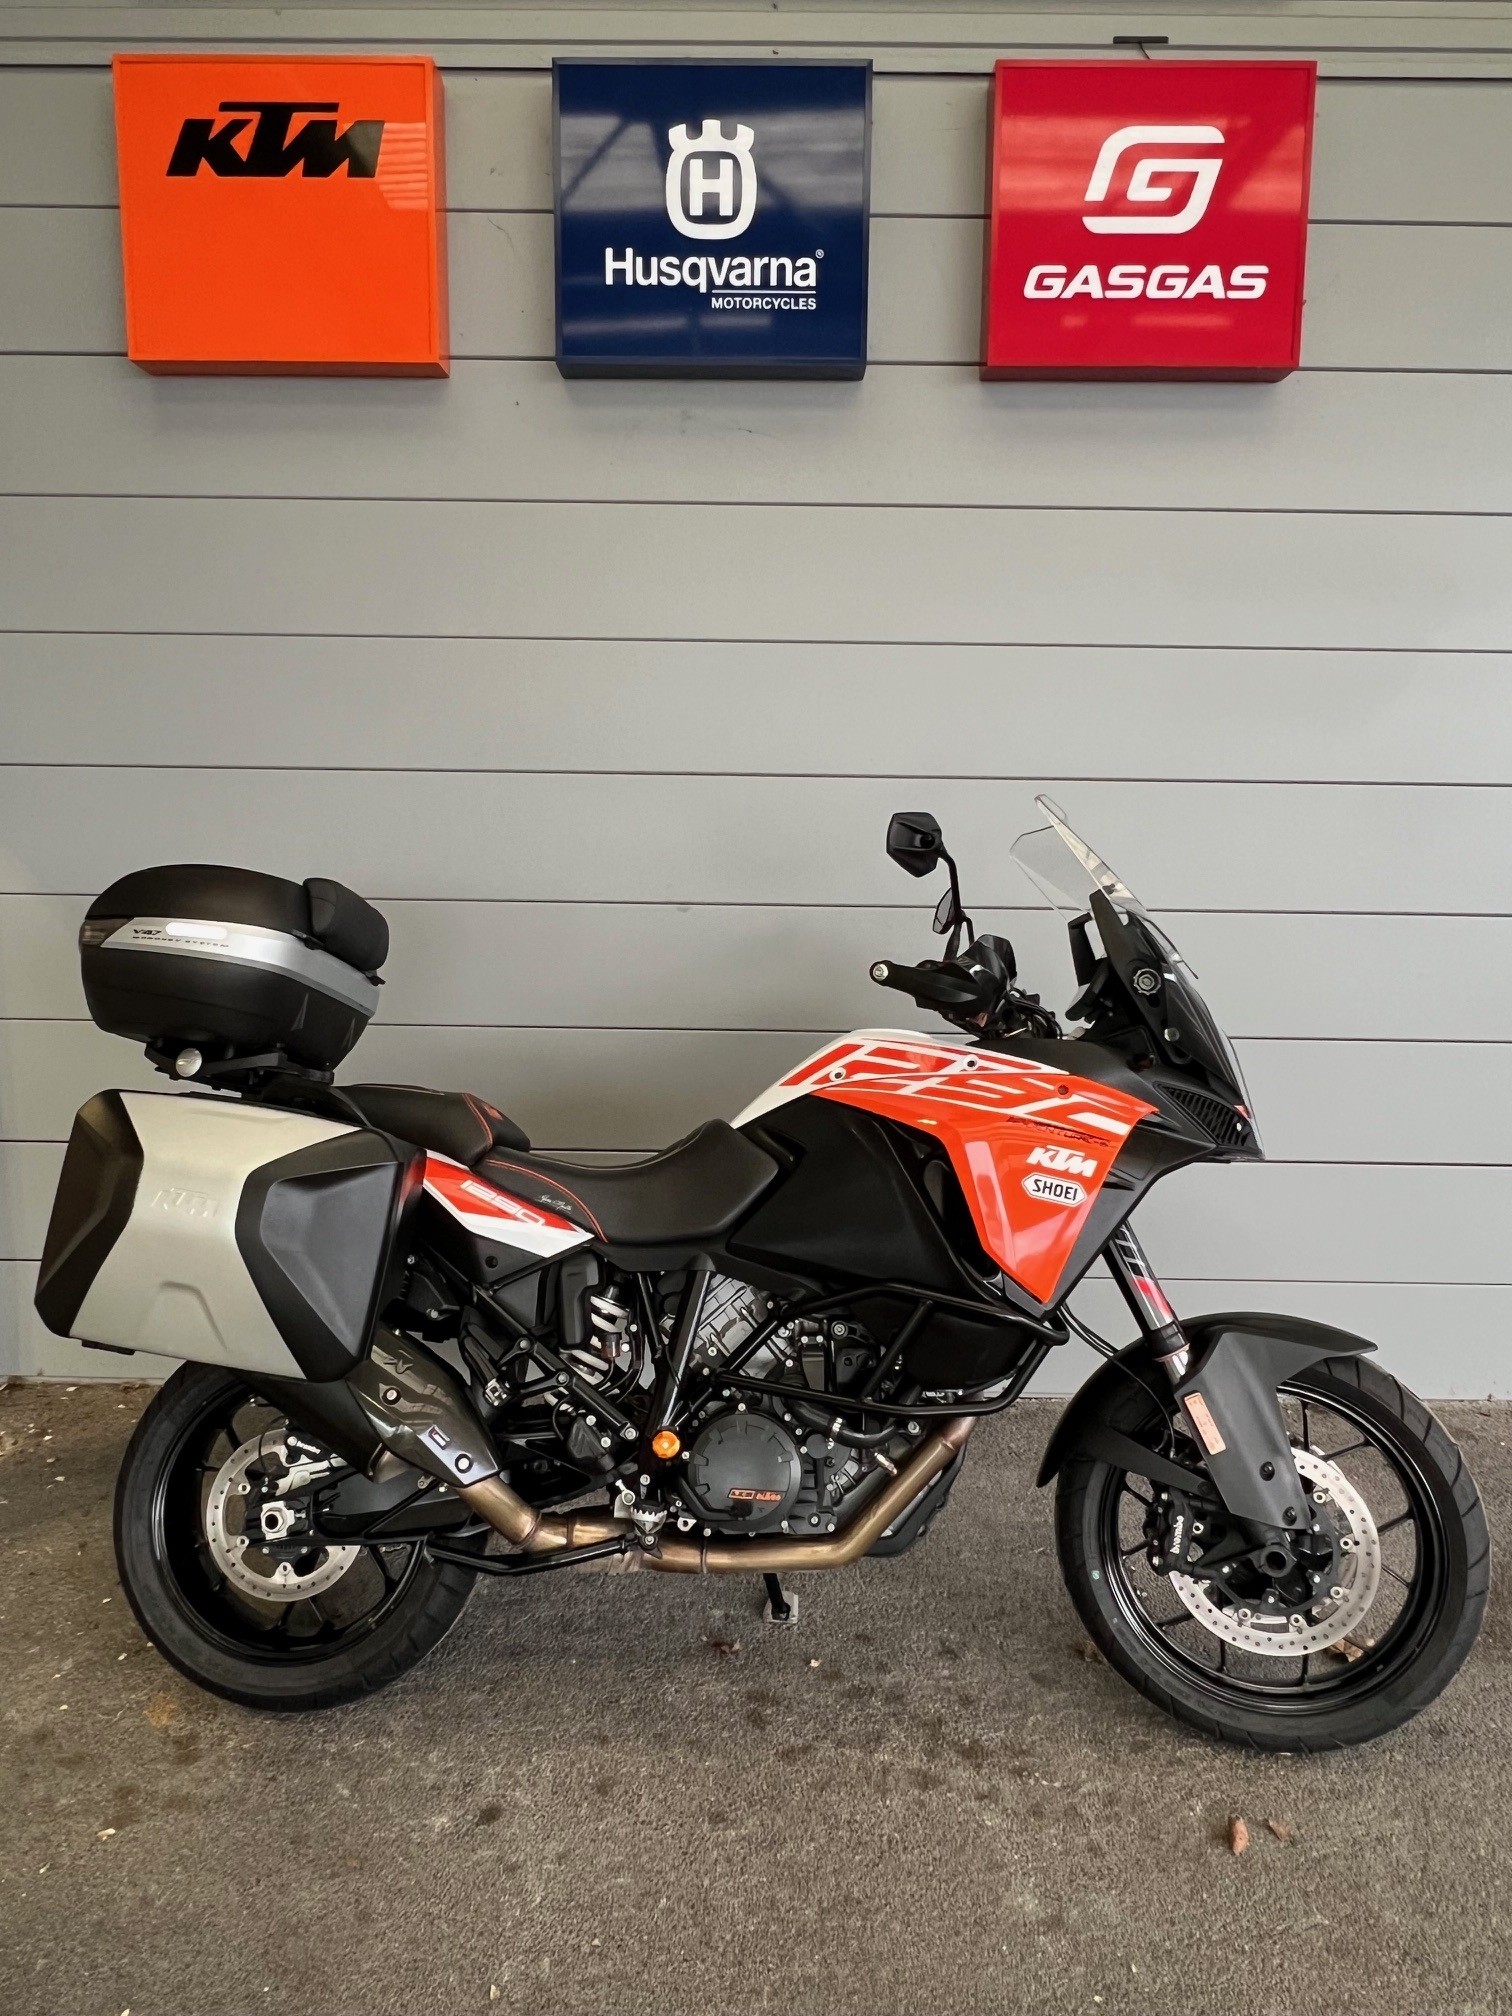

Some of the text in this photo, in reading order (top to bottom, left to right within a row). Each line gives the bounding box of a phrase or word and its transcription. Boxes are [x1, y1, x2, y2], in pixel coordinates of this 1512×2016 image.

[166, 101, 386, 178] KTM
[1023, 264, 1270, 299] GASGAS
[711, 297, 817, 310] MOTORCYCLES
[1026, 1144, 1098, 1178] KTM
[1032, 1178, 1078, 1201] SHOEI
